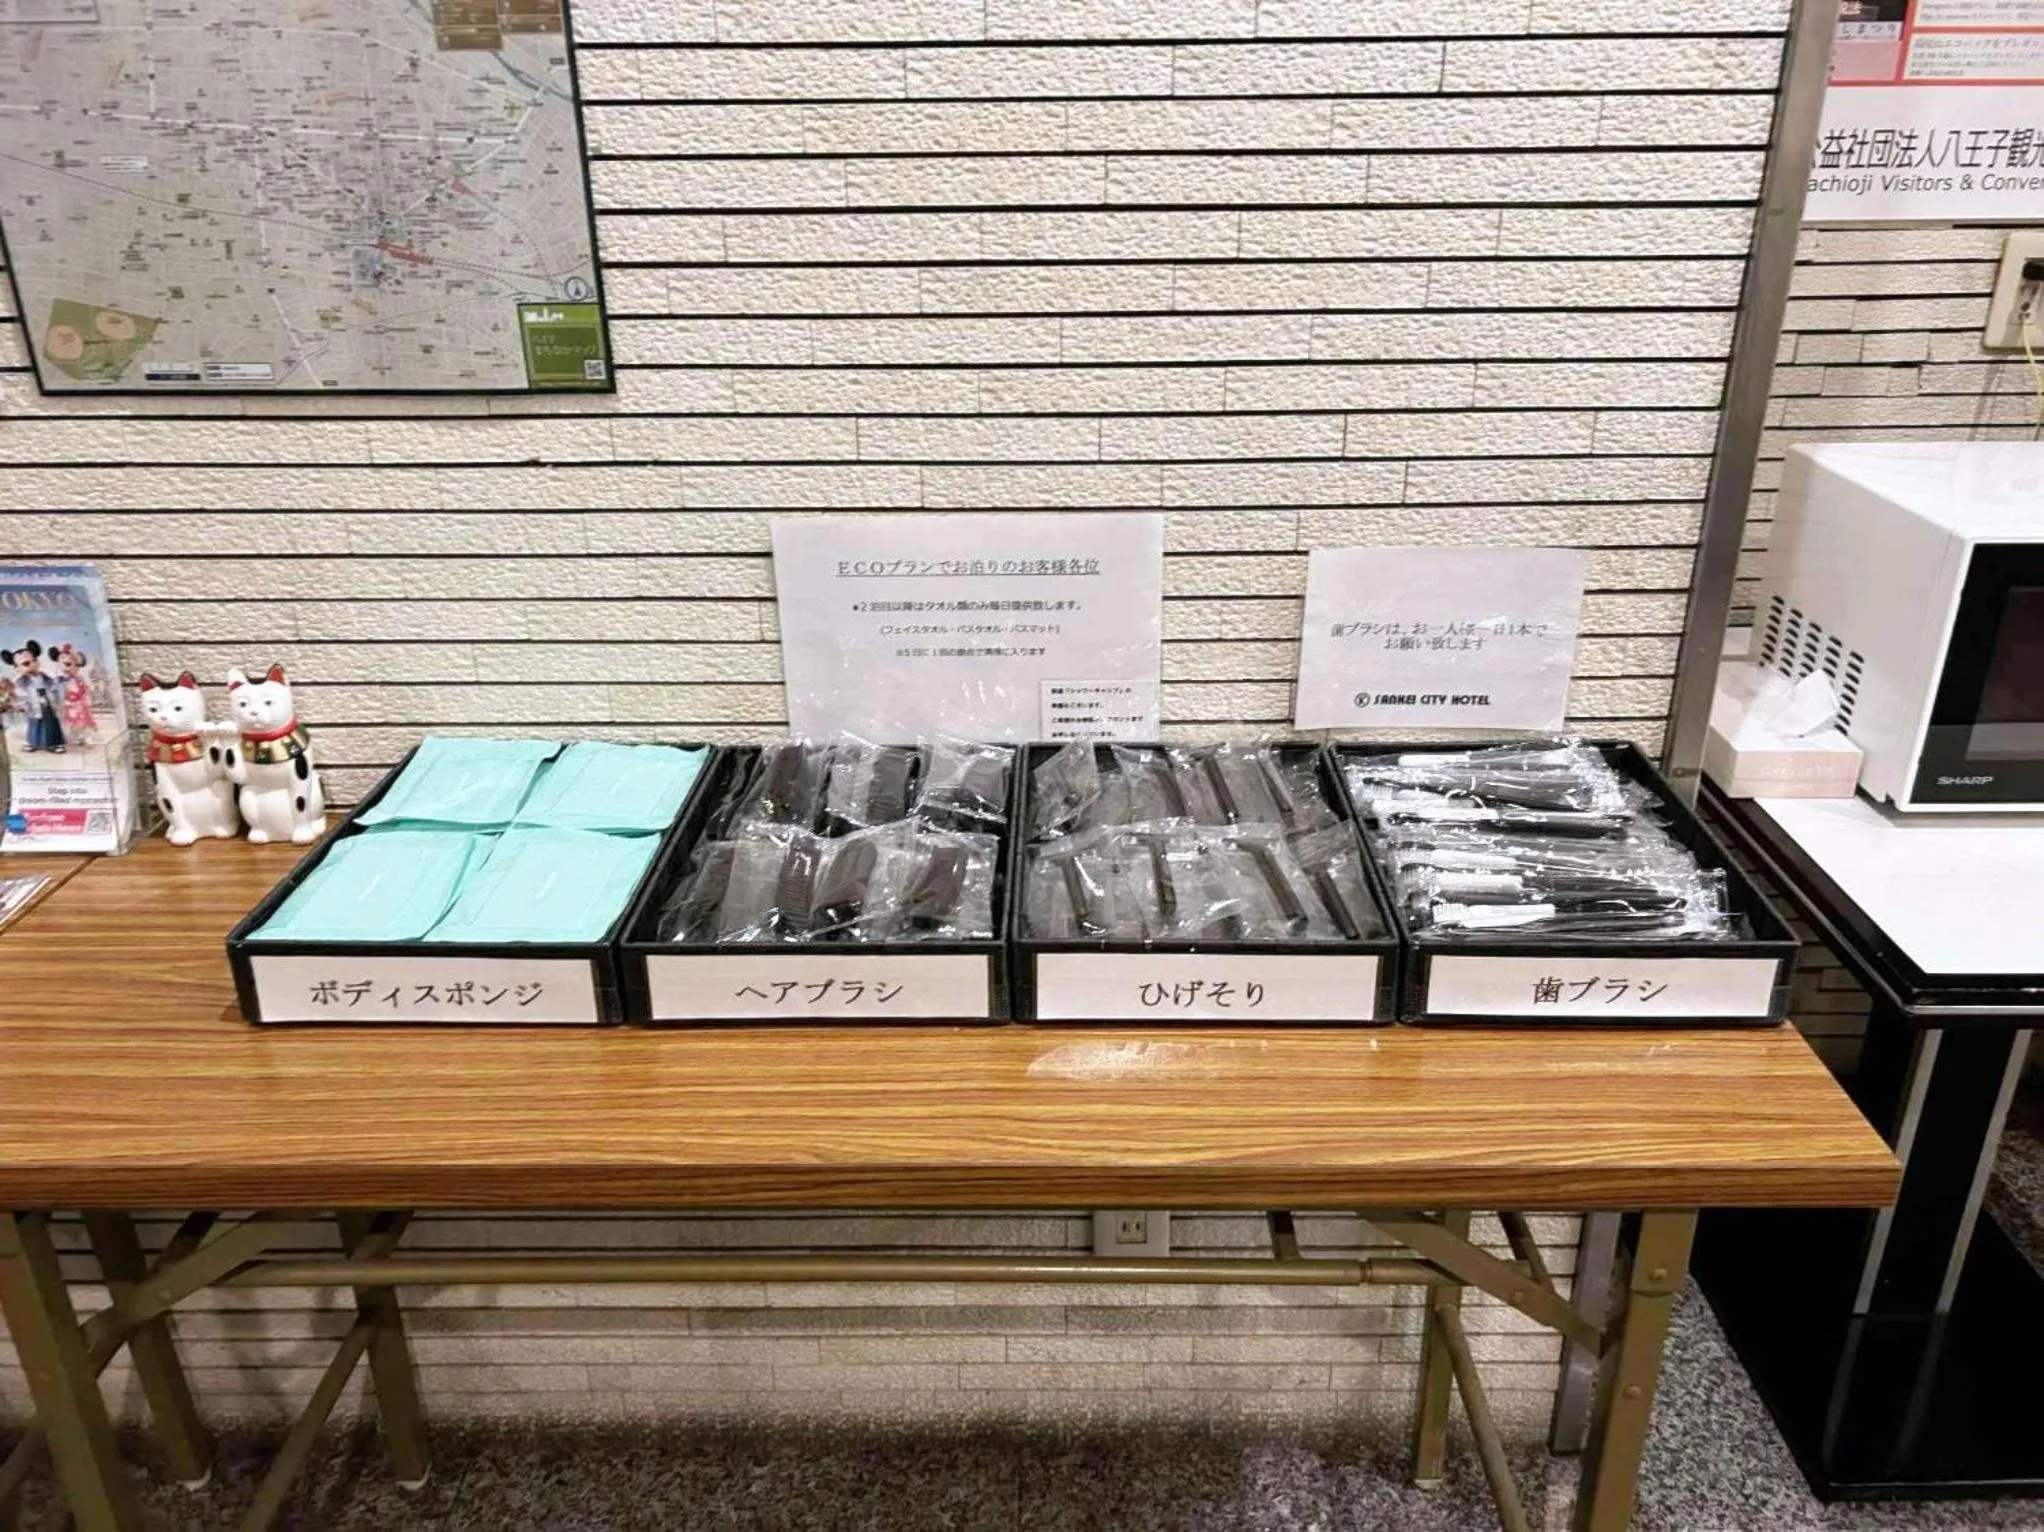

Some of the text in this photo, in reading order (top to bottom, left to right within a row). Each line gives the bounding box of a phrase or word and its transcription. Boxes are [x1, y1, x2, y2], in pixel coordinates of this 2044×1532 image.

[1881, 174, 1953, 192] Visitors
[1960, 175, 1974, 191] &
[1372, 694, 1491, 706] SANKEI CITY HOTEL
[1937, 776, 1993, 785] SHARP
[309, 979, 544, 1007] ボディスポンジ
[735, 978, 903, 1005] ヘアブラシ
[1139, 980, 1264, 1007] ひげそり
[1532, 976, 1668, 1005] 歯ブラシ
